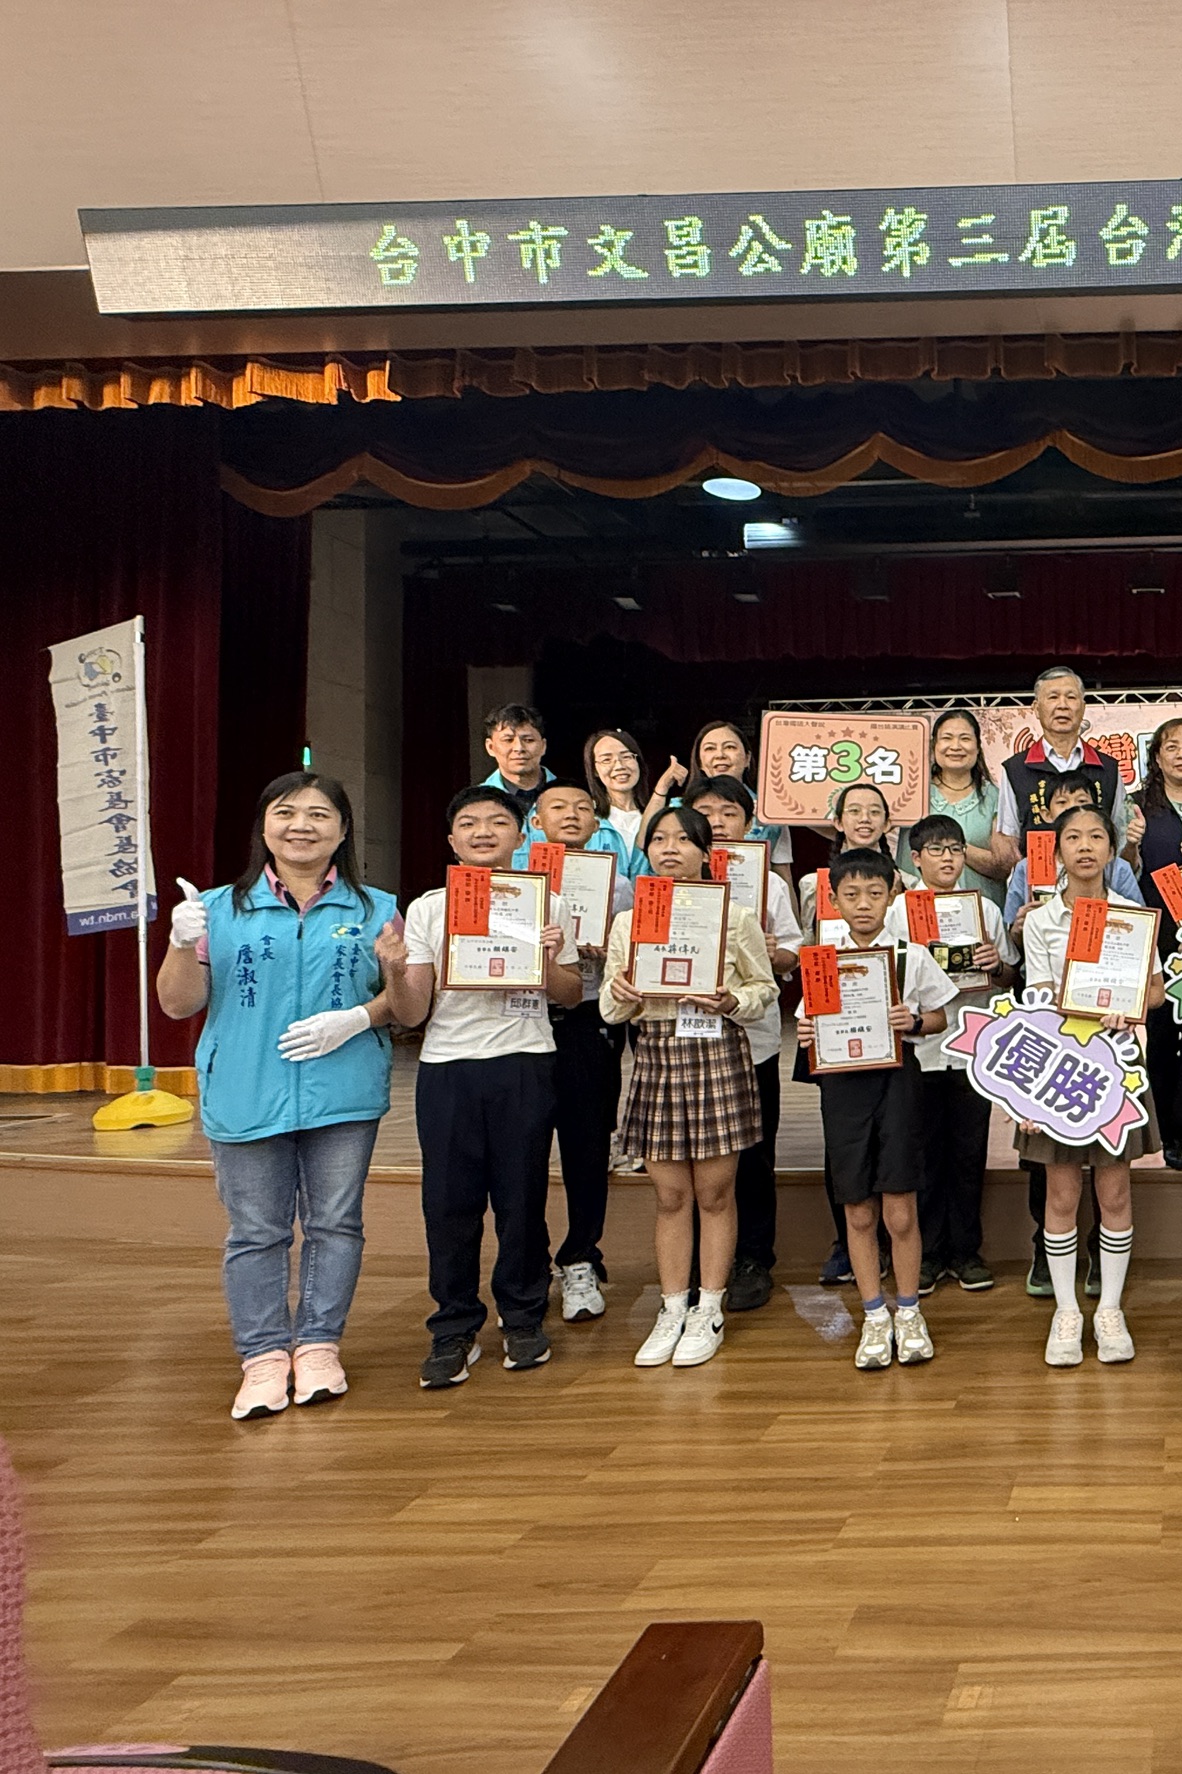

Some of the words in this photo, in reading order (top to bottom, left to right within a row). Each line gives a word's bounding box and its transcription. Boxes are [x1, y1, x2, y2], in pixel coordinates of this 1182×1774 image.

[789, 740, 903, 784] 第3名
[260, 934, 276, 961] 會長
[986, 1022, 1110, 1123] 優勝
